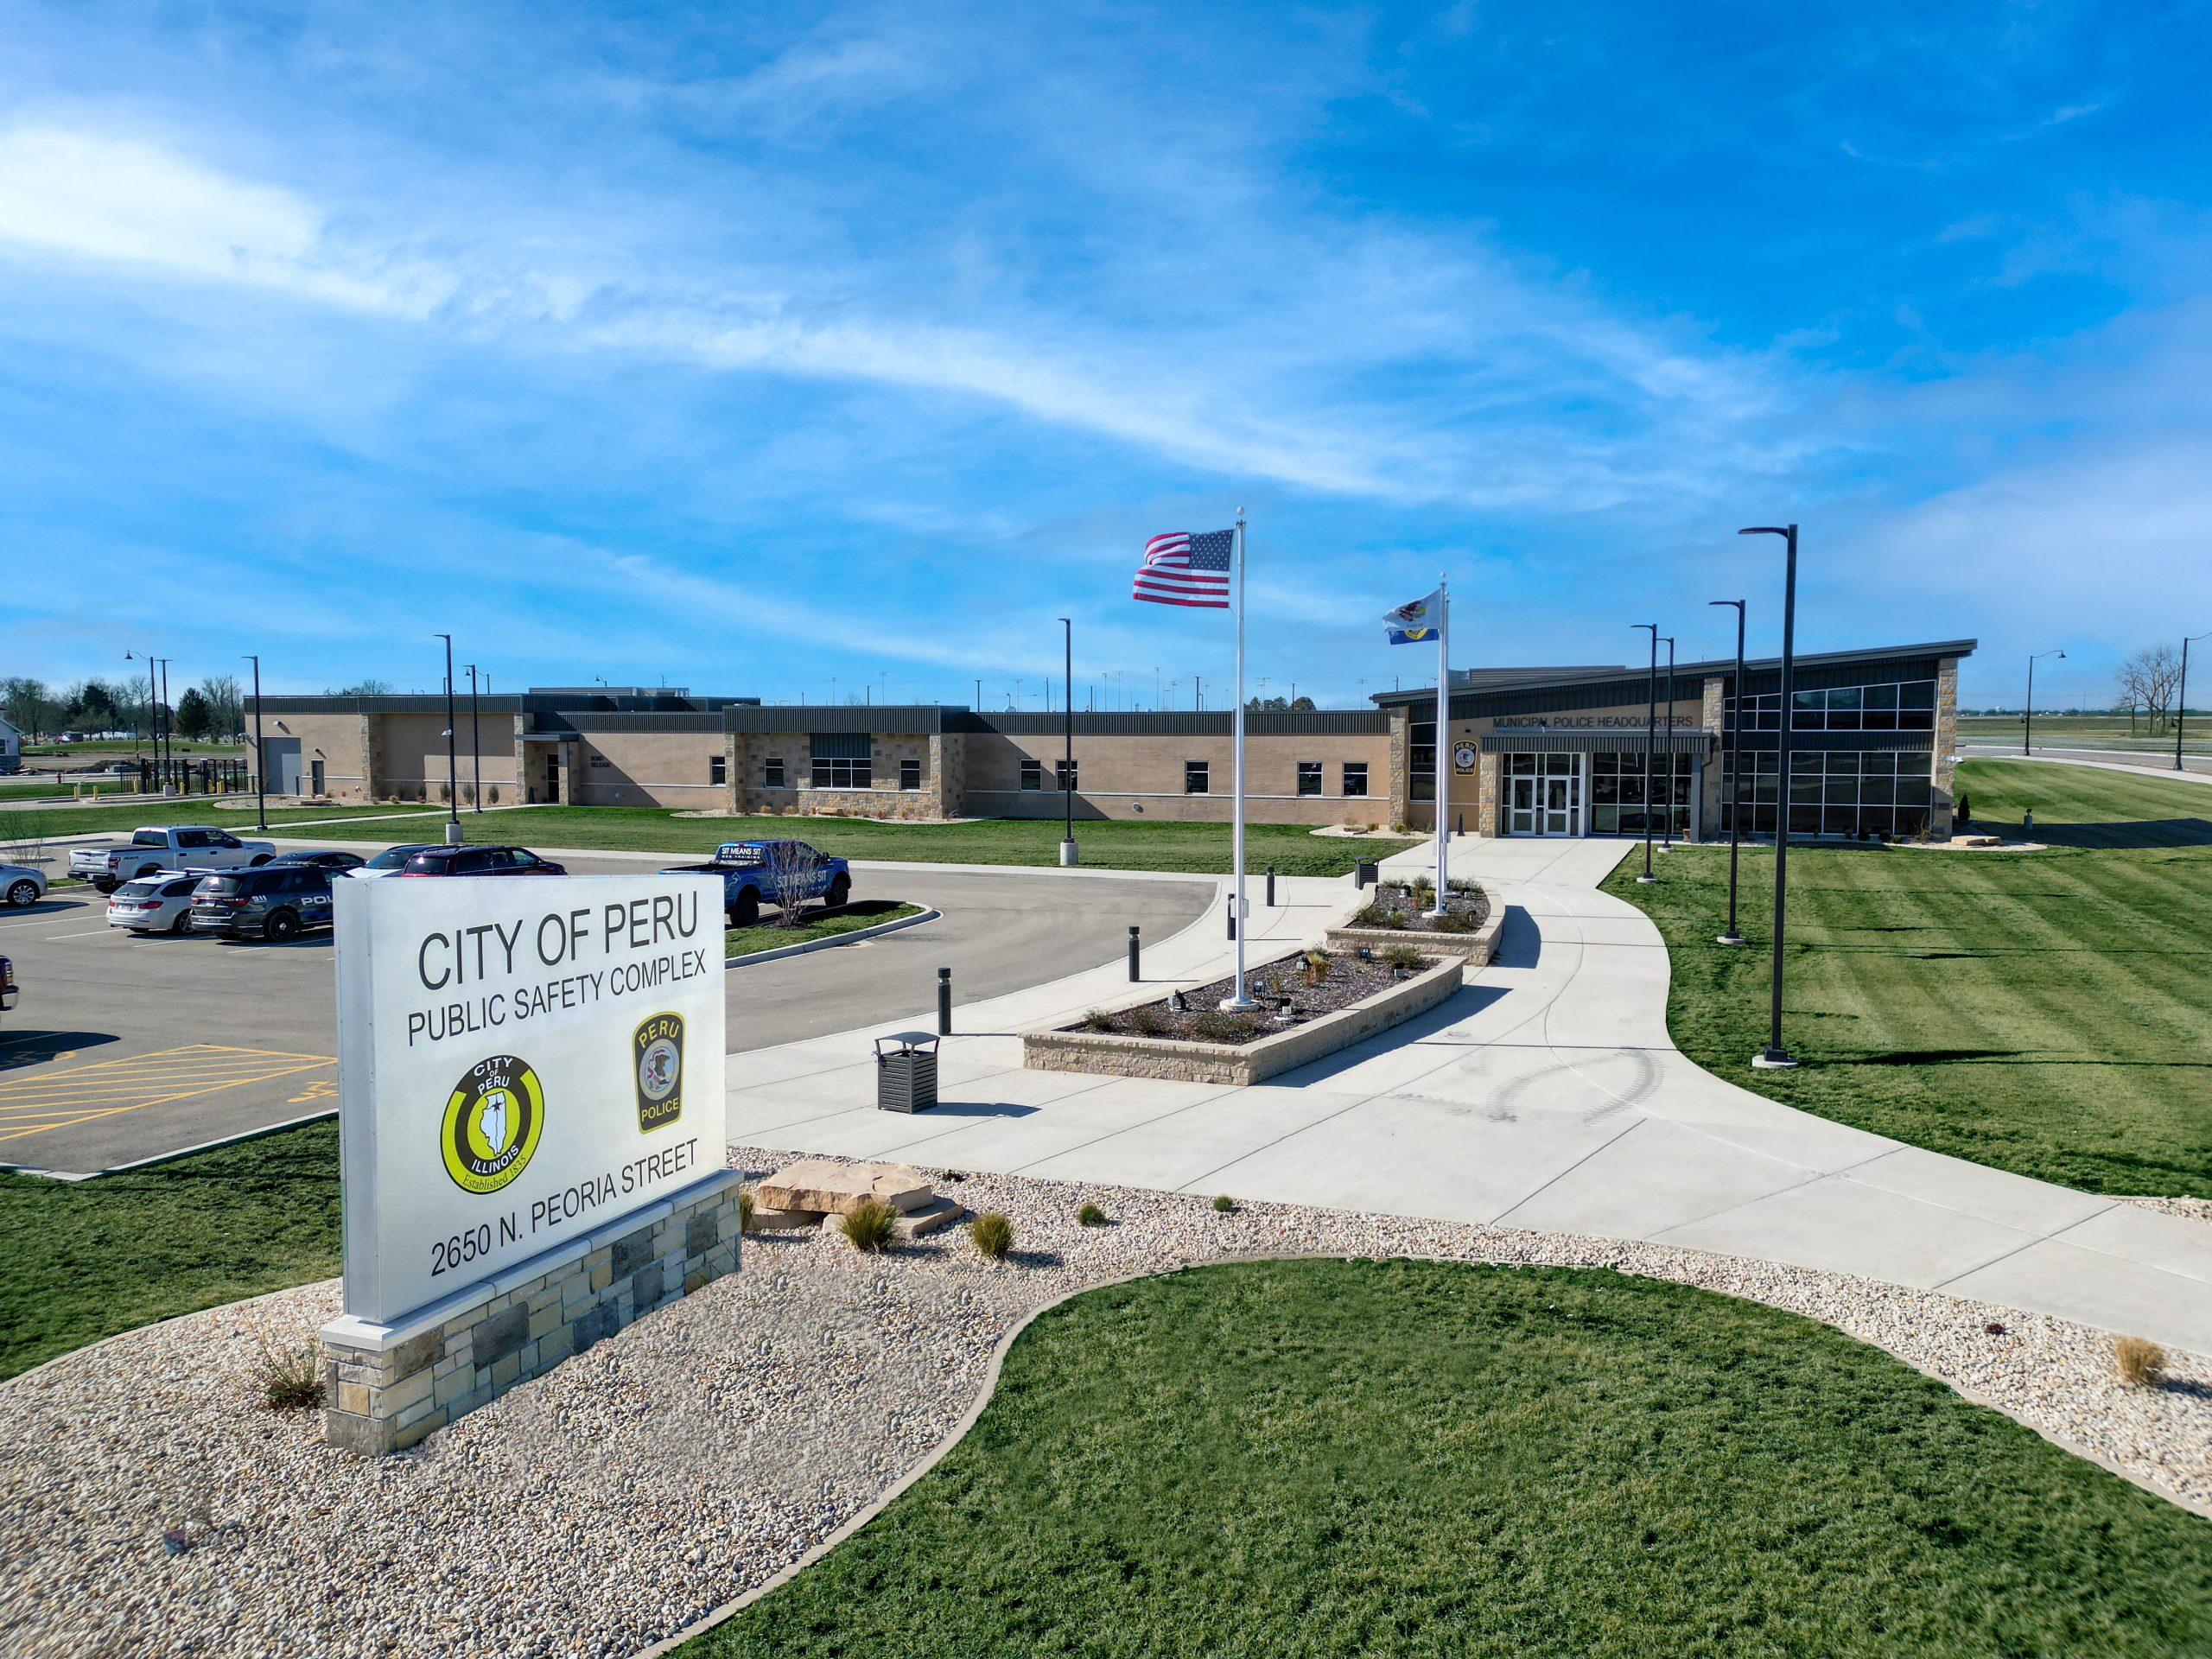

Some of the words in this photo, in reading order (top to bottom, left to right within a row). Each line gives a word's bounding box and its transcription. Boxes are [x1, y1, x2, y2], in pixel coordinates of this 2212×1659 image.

[1493, 716, 1550, 728] MUNICIPAL
[1554, 716, 1594, 728] POLICE
[1598, 716, 1693, 728] HEADQUARTERS
[731, 847, 752, 855] MEANS
[817, 869, 827, 882] SIT
[251, 894, 267, 903] 911
[301, 894, 333, 906] POL
[419, 919, 523, 990] CITY
[537, 908, 590, 966] OF
[605, 891, 696, 953] PERU
[409, 995, 505, 1047] PUBLIC
[515, 971, 603, 1020] SAFETY
[611, 949, 706, 995] COMPLEX
[639, 1020, 679, 1048] PERU
[474, 1057, 513, 1077] CITY
[477, 1076, 510, 1096] PERU
[641, 1097, 679, 1122] POLICE
[472, 1145, 519, 1173] ILLINOIS
[462, 1173, 509, 1191] Established
[510, 1154, 526, 1178] 1835
[429, 1224, 491, 1278] 2650
[500, 1212, 523, 1247] N.
[532, 1173, 616, 1233] PEORIA
[622, 1138, 698, 1193] STREET
